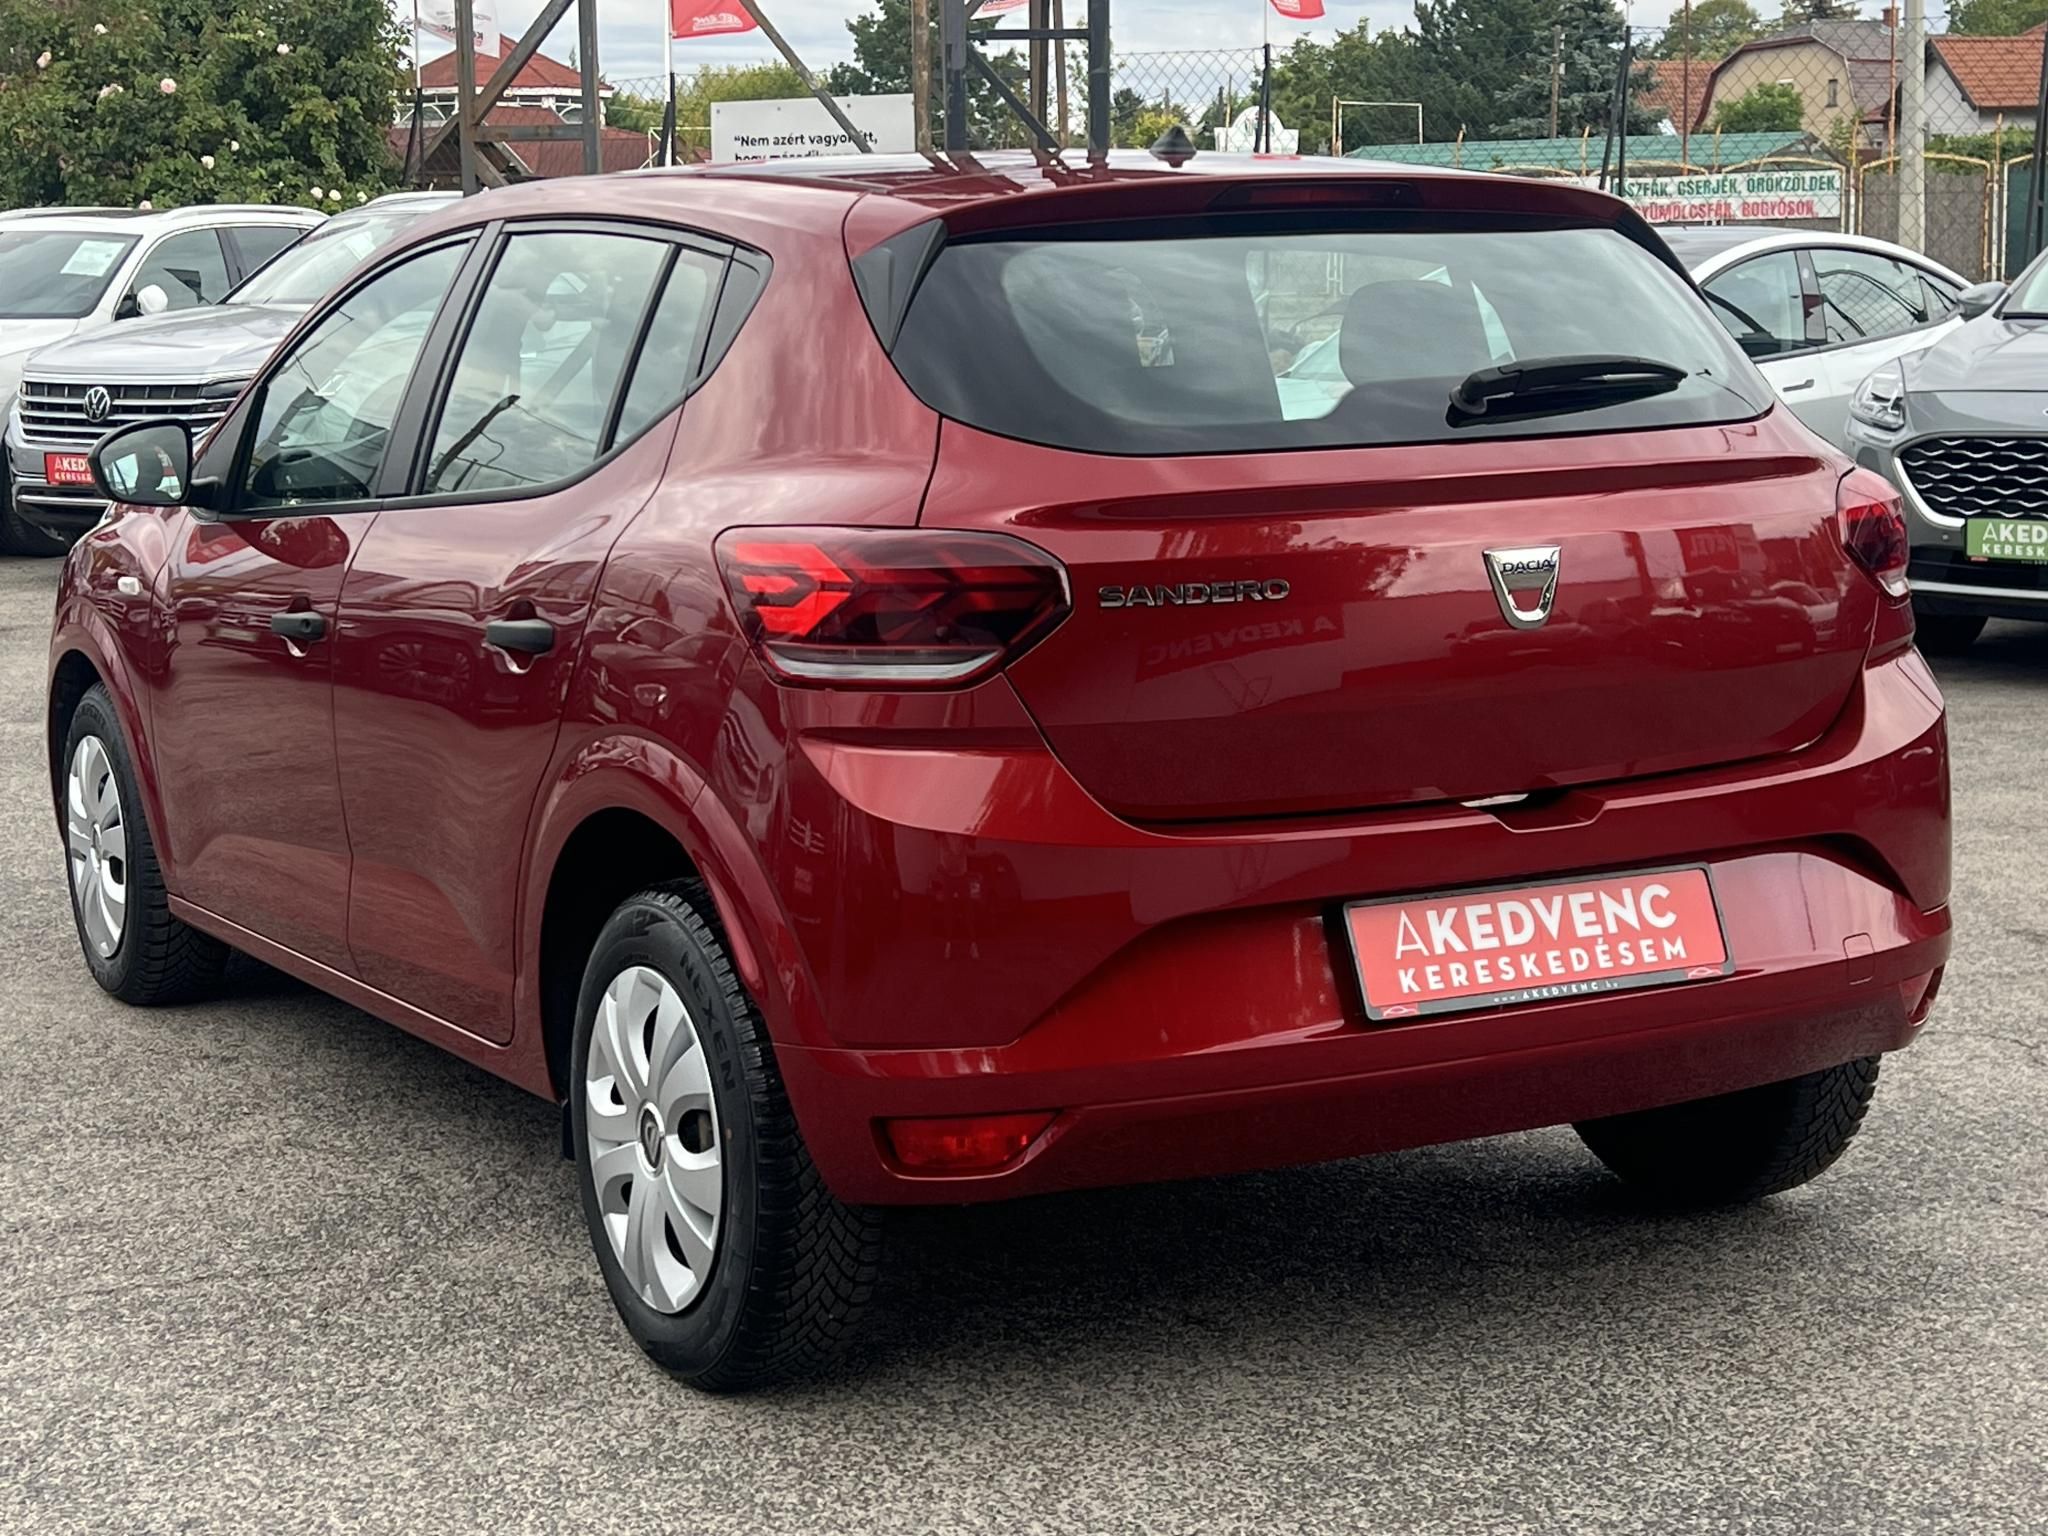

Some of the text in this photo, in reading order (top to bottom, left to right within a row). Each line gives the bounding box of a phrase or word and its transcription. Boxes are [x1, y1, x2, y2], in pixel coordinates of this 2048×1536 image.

[773, 132, 805, 146] azért
[1982, 544, 2046, 557] KERESK
[1502, 559, 1553, 573] DACIA
[1098, 578, 1290, 608] SANDERO
[1395, 884, 1678, 960] AKEDVENC
[1398, 935, 1688, 994] KERESKEDÉSEM
[679, 951, 736, 1091] NEXEN
